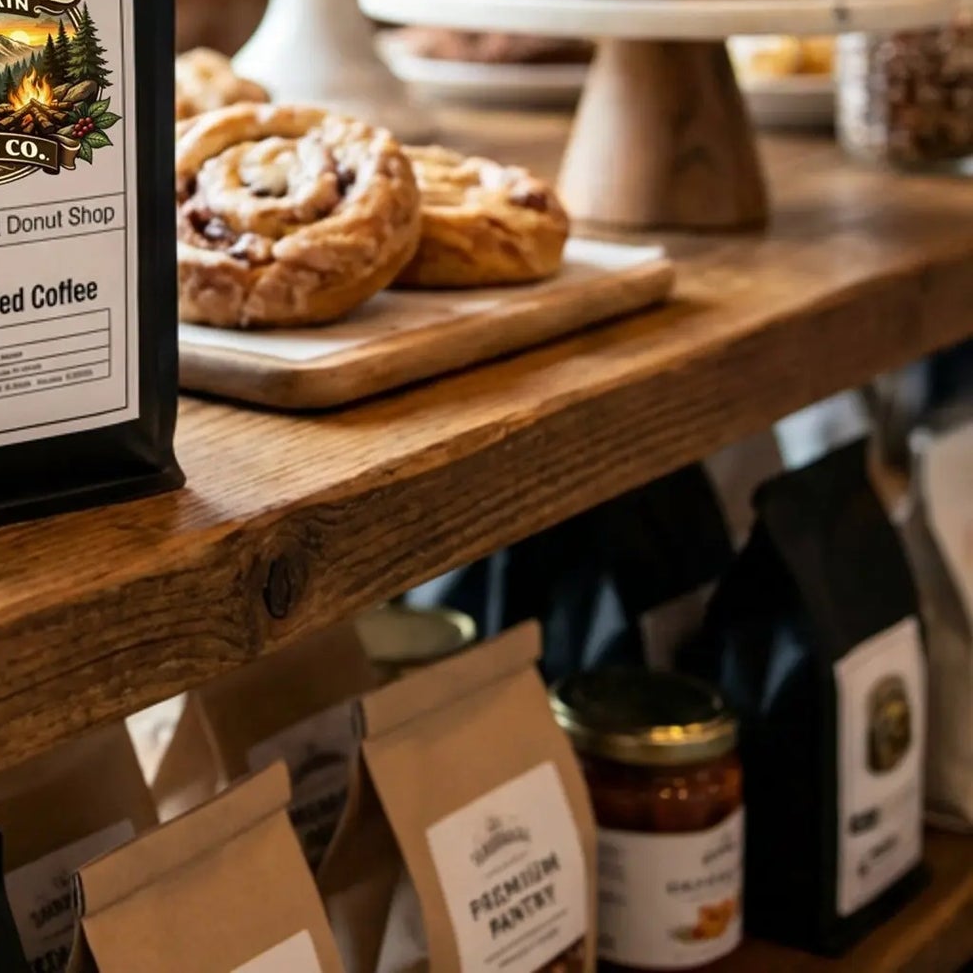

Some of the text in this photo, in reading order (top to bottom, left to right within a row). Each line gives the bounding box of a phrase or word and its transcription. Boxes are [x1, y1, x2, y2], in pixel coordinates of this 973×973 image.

[6, 210, 63, 235] Donut
[68, 205, 115, 226] Shop
[31, 277, 98, 310] Coffee
[468, 851, 562, 923] PREMIUM
[489, 883, 557, 940] PANTRY
